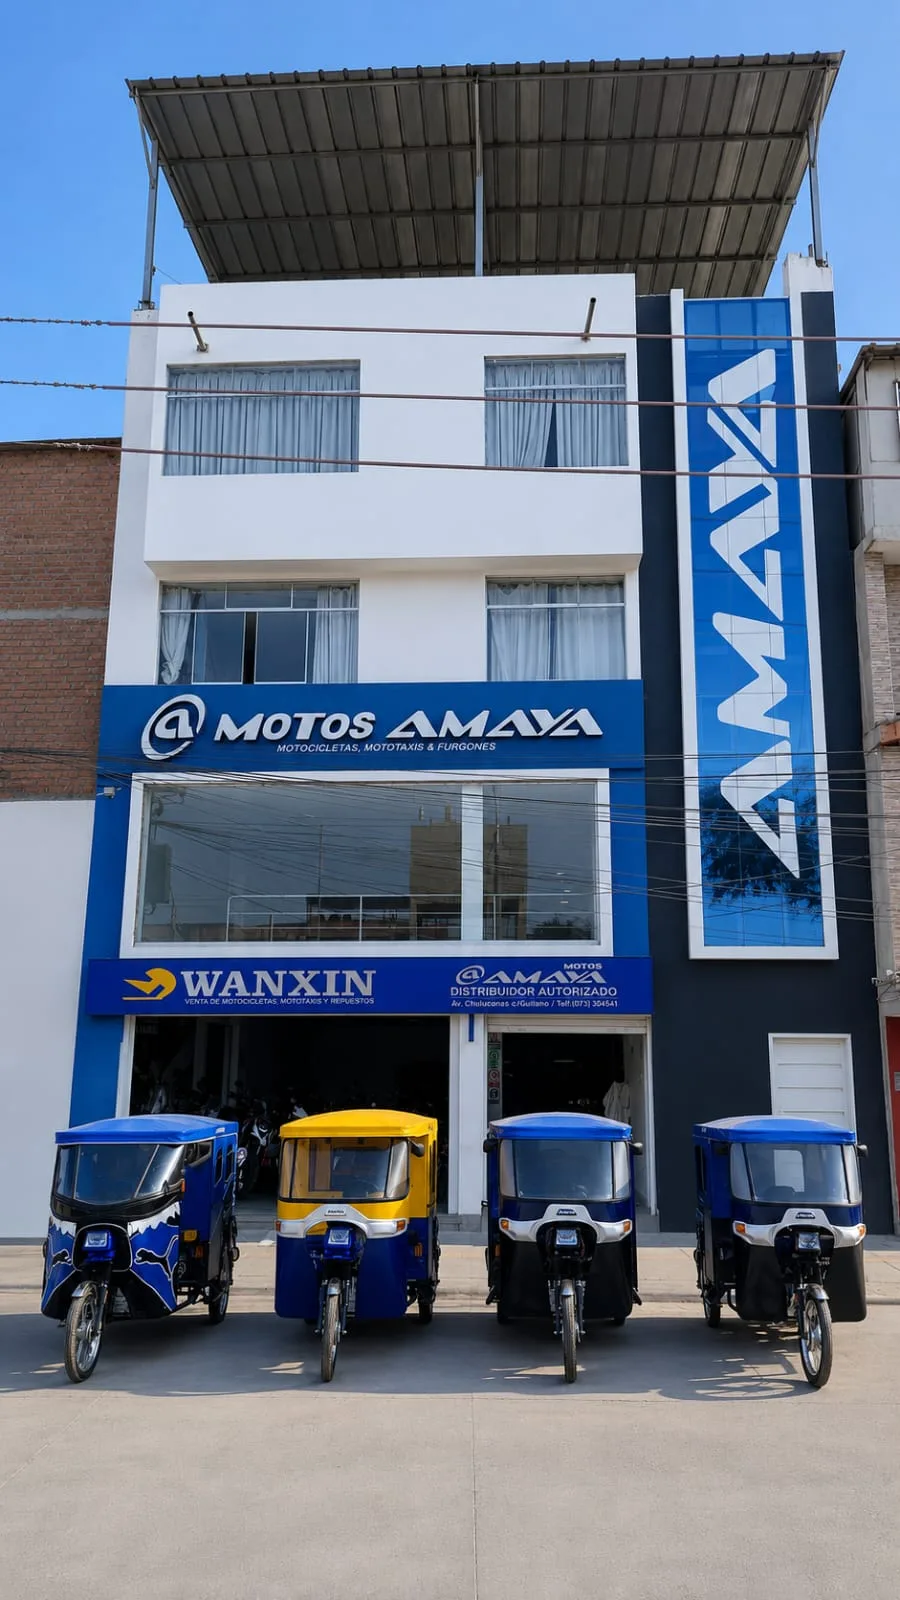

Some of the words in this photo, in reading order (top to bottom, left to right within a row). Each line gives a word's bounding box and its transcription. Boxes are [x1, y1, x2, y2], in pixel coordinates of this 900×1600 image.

[707, 348, 800, 880] AMAYA
[213, 711, 376, 741] MOTOS
[385, 708, 604, 739] AMAYA
[276, 743, 361, 753] MOTOCICLETAS,
[363, 743, 424, 752] MOTOTAXIS
[427, 743, 435, 752] &
[437, 742, 497, 751] FURGONES
[563, 962, 603, 970] MOTOS
[482, 970, 608, 984] AMAYA
[180, 970, 377, 997] WANXIN
[450, 986, 535, 996] DISTRIBUIDOR
[538, 986, 618, 996] AUTORIZADO
[451, 1000, 463, 1008] Av.
